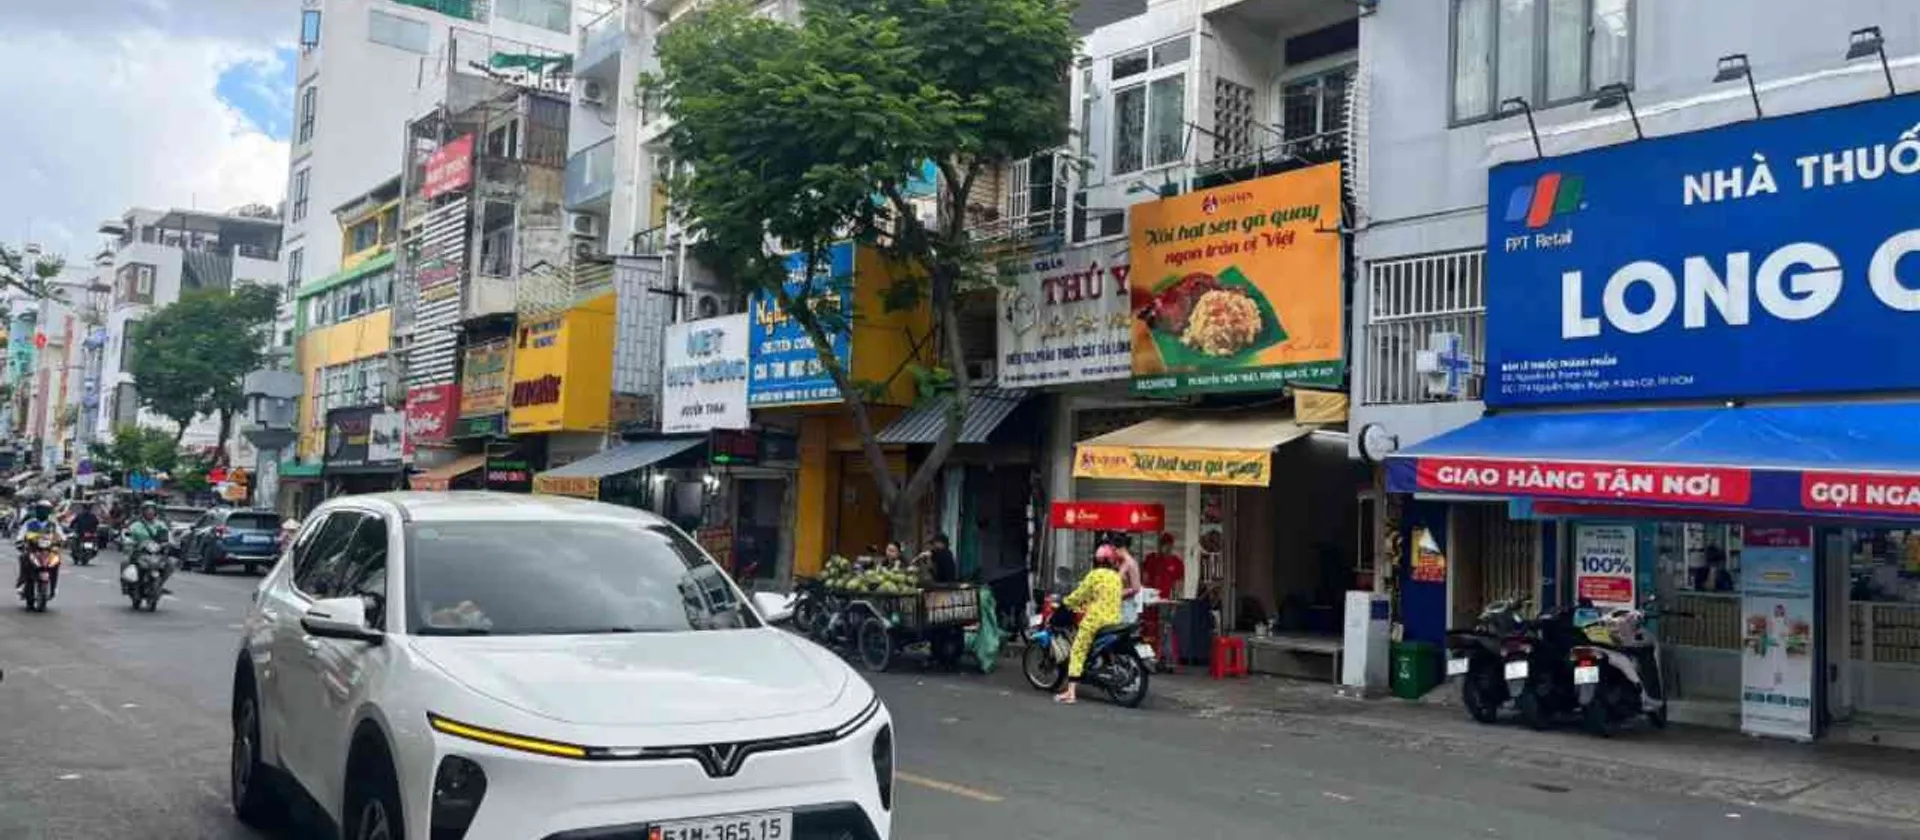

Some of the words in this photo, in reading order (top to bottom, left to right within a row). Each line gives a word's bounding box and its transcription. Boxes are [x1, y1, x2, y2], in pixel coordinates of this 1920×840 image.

[1683, 153, 1777, 205] NHÀ
[1209, 219, 1237, 235] sen
[1270, 204, 1320, 228] quay
[1164, 247, 1203, 267] ngon
[1260, 229, 1296, 251] Việt
[1506, 235, 1531, 252] FPT
[1536, 229, 1573, 249] Retail
[1042, 261, 1105, 305] THÚ
[1110, 264, 1131, 297] Y
[1561, 242, 1843, 339] LONG
[1437, 465, 1500, 486] GIAO
[1507, 465, 1586, 490] HÀNG
[1593, 467, 1654, 498] TẬN
[1662, 473, 1720, 497] NƠI
[1810, 482, 1858, 507] GỌI
[1582, 555, 1632, 574] 100%
